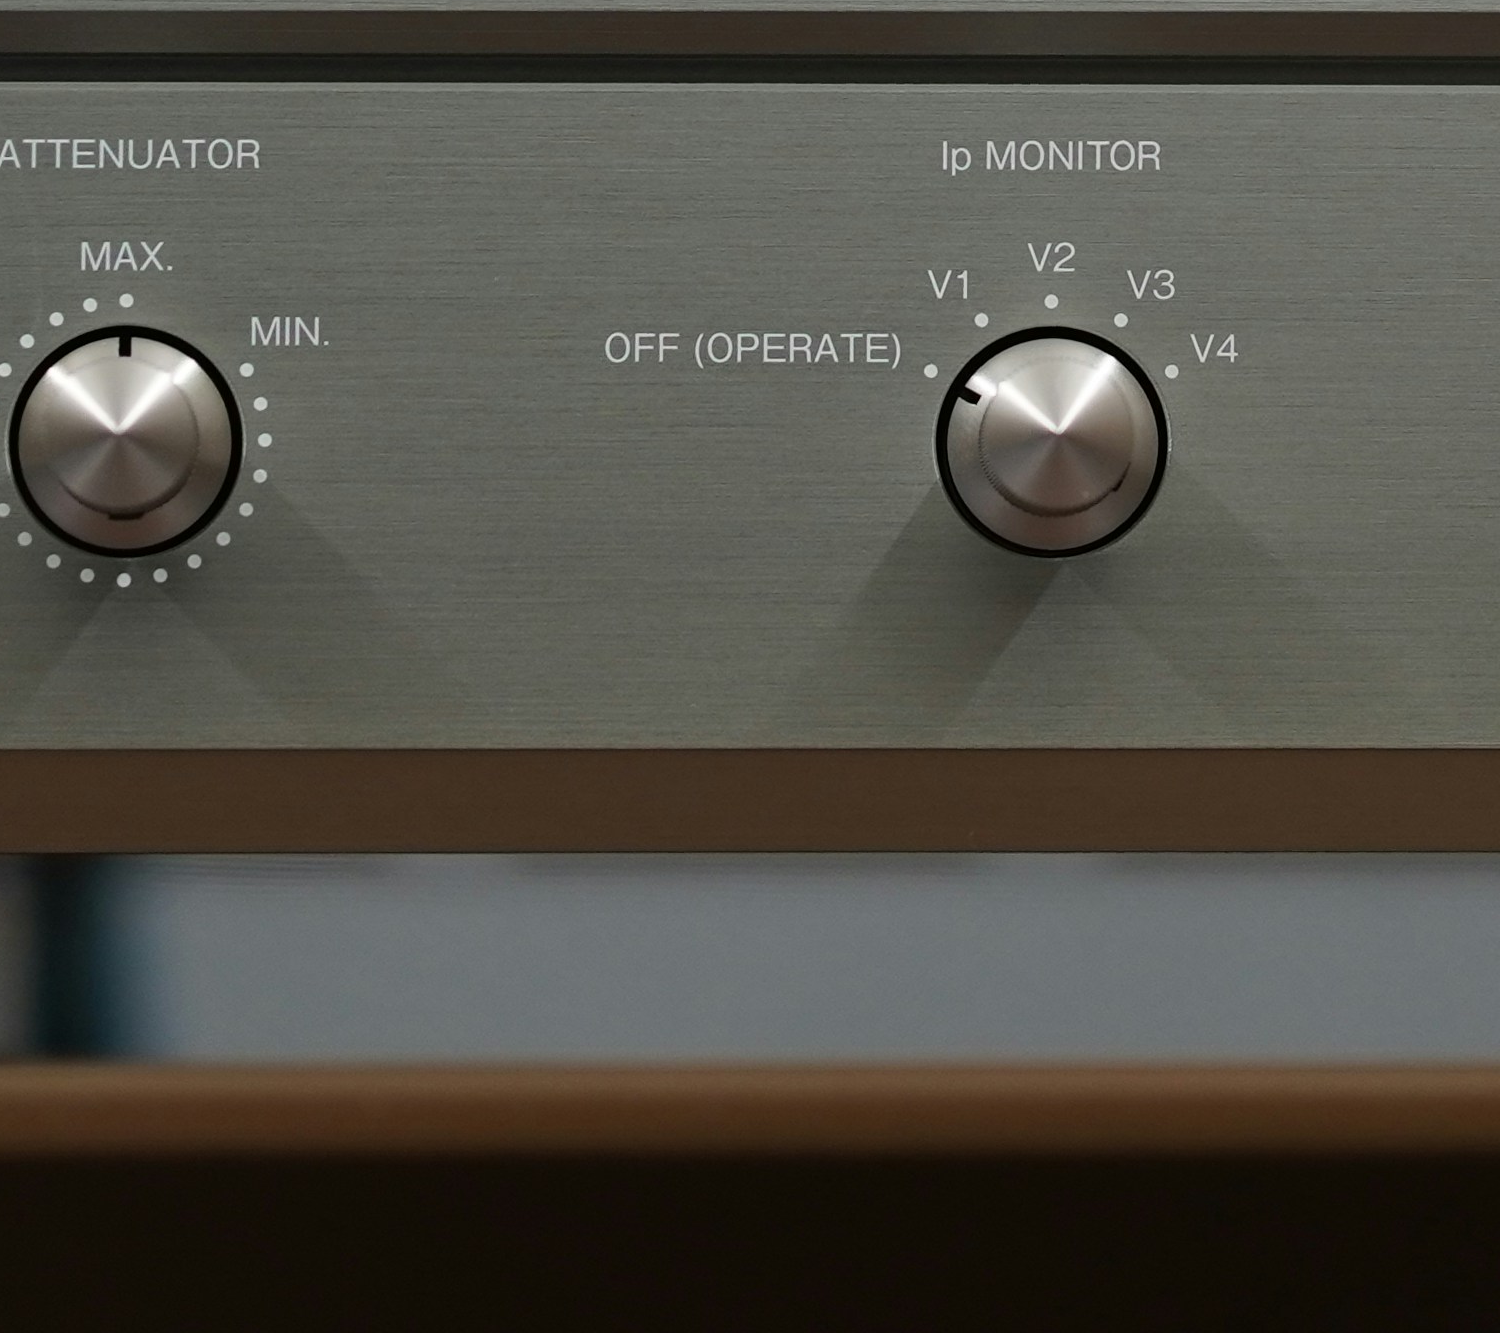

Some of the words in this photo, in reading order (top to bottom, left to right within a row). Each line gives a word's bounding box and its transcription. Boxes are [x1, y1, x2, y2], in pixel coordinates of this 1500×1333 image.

[943, 141, 973, 178] Ip
[987, 140, 1162, 173] MONITOR
[81, 242, 174, 273] MAX.
[1028, 242, 1077, 274] V2
[928, 270, 969, 301] V1
[1127, 270, 1177, 302] V3
[251, 317, 331, 348] MIN.
[605, 332, 681, 365] OFF
[694, 332, 902, 371] (OPERATE)
[1190, 334, 1240, 365] V4
